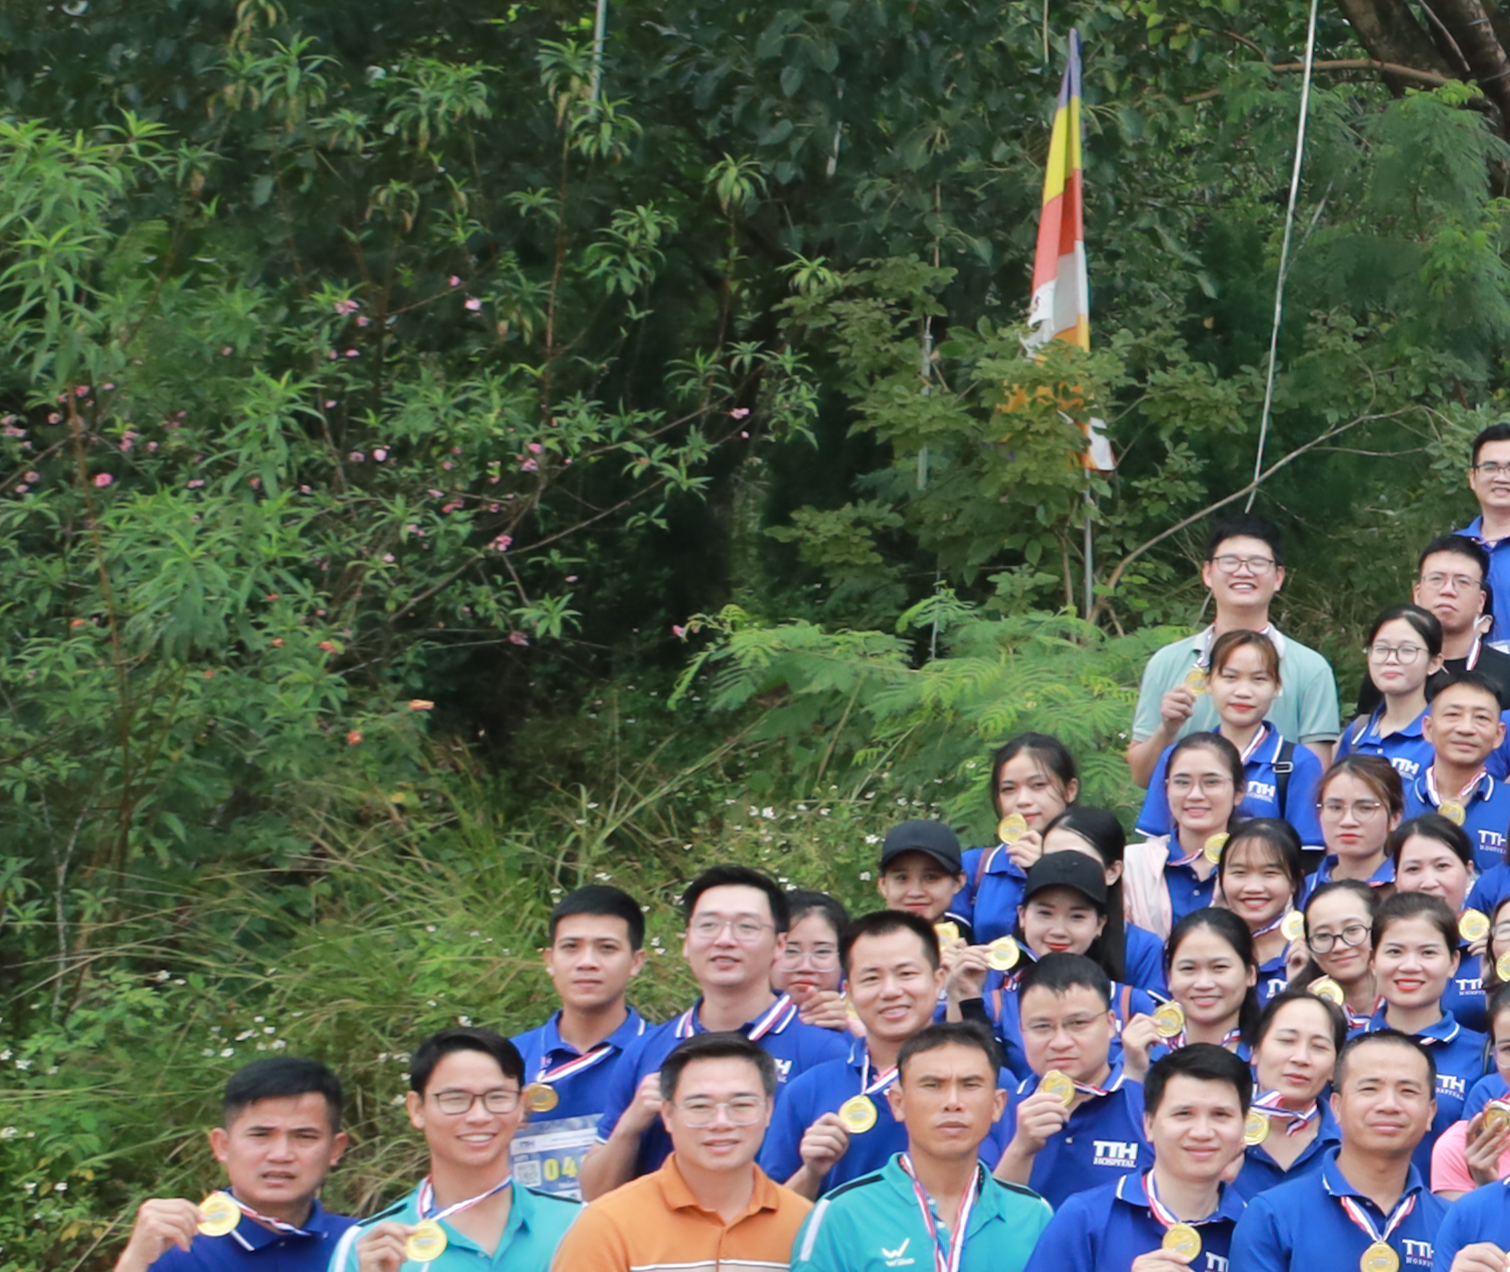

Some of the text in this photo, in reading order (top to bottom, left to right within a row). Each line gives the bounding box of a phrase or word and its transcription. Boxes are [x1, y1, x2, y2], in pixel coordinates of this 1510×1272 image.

[1392, 758, 1419, 774] TTH
[1248, 781, 1275, 797] TTH
[1093, 1141, 1138, 1160] TTH
[1093, 1158, 1136, 1168] HOSPITAL
